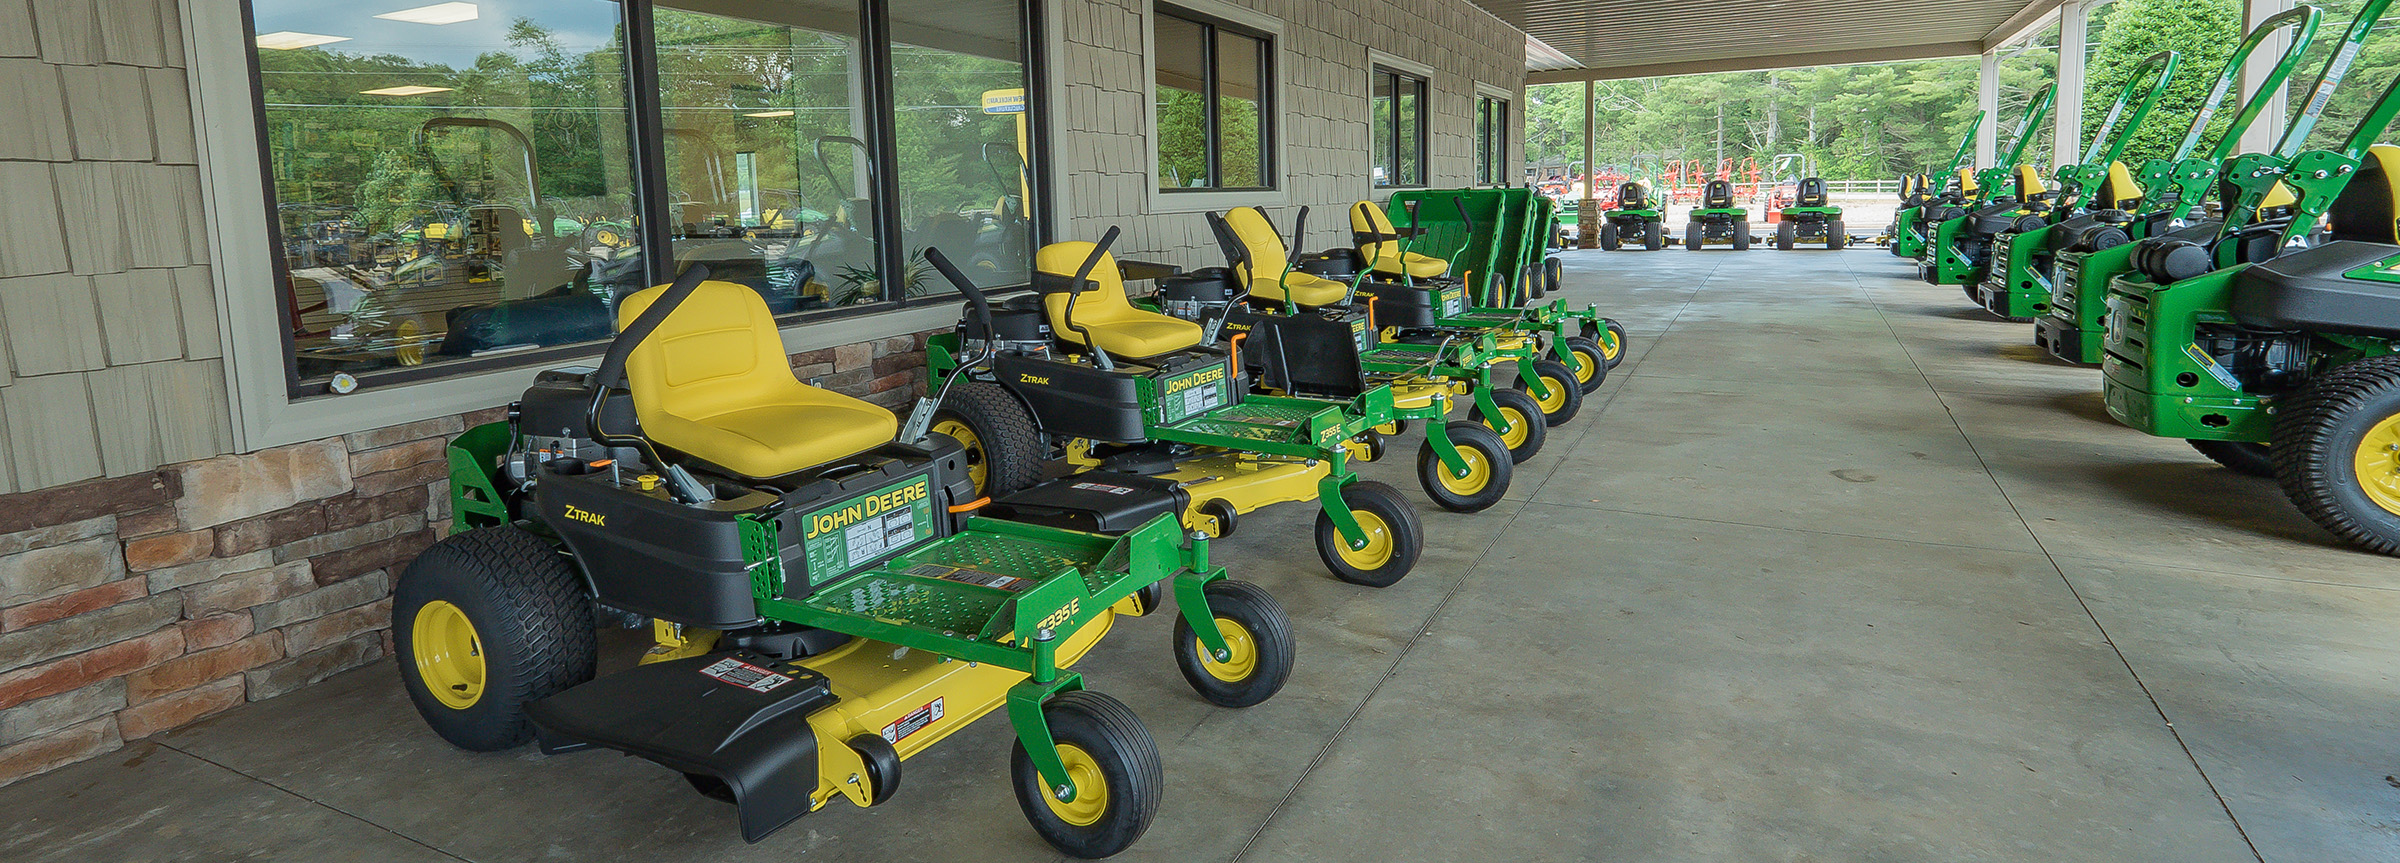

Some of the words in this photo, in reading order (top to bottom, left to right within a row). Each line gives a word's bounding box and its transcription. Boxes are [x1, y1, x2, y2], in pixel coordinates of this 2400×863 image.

[1226, 322, 1251, 331] ZTRAK
[1020, 373, 1049, 385] ZTRAK
[1166, 377, 1192, 395] JOHN
[1193, 368, 1223, 386] DEERE
[564, 504, 606, 527] ZTRAK
[807, 504, 862, 539] JOHN
[865, 481, 927, 517] DEERE
